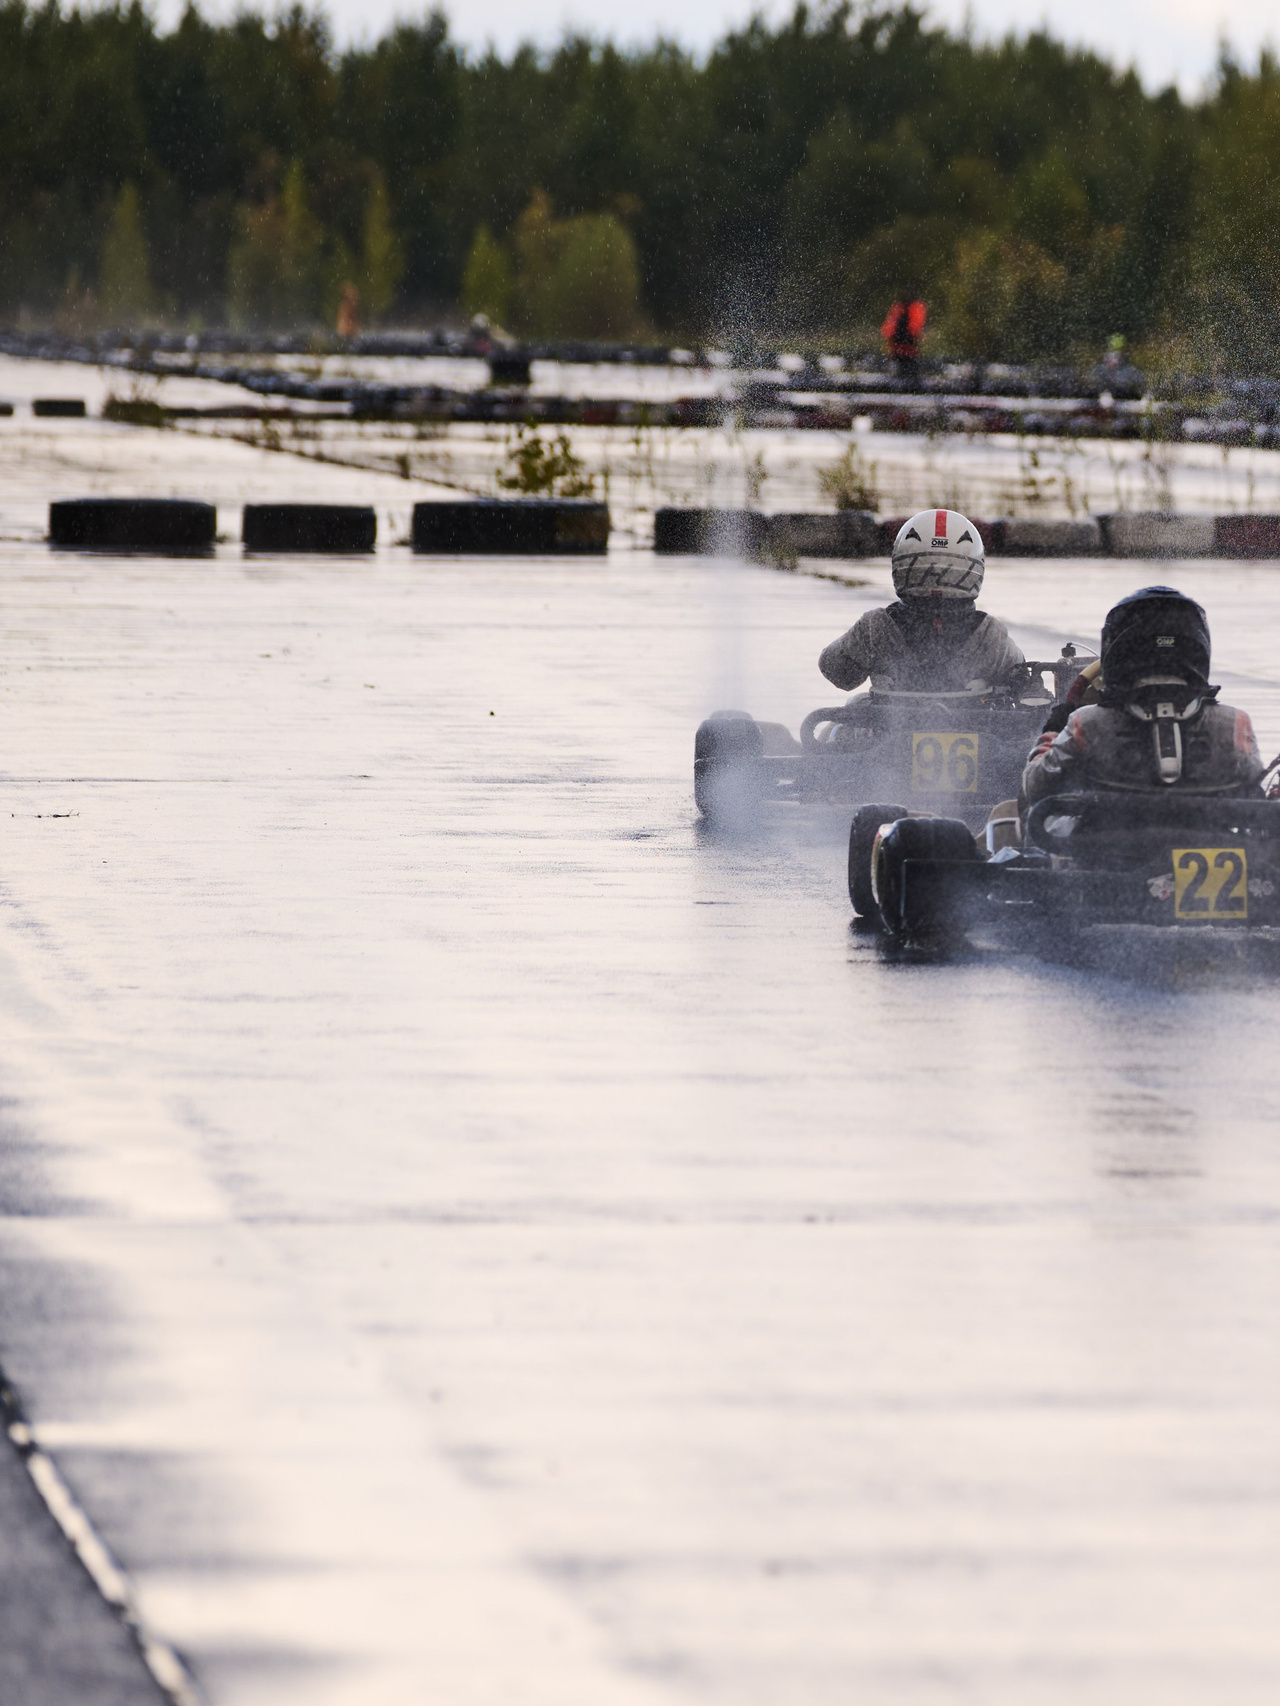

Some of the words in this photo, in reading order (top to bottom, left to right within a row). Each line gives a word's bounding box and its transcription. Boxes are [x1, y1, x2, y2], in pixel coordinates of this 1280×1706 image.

[931, 539, 949, 547] OMP
[915, 736, 976, 790] 96
[1178, 851, 1244, 912] 22
